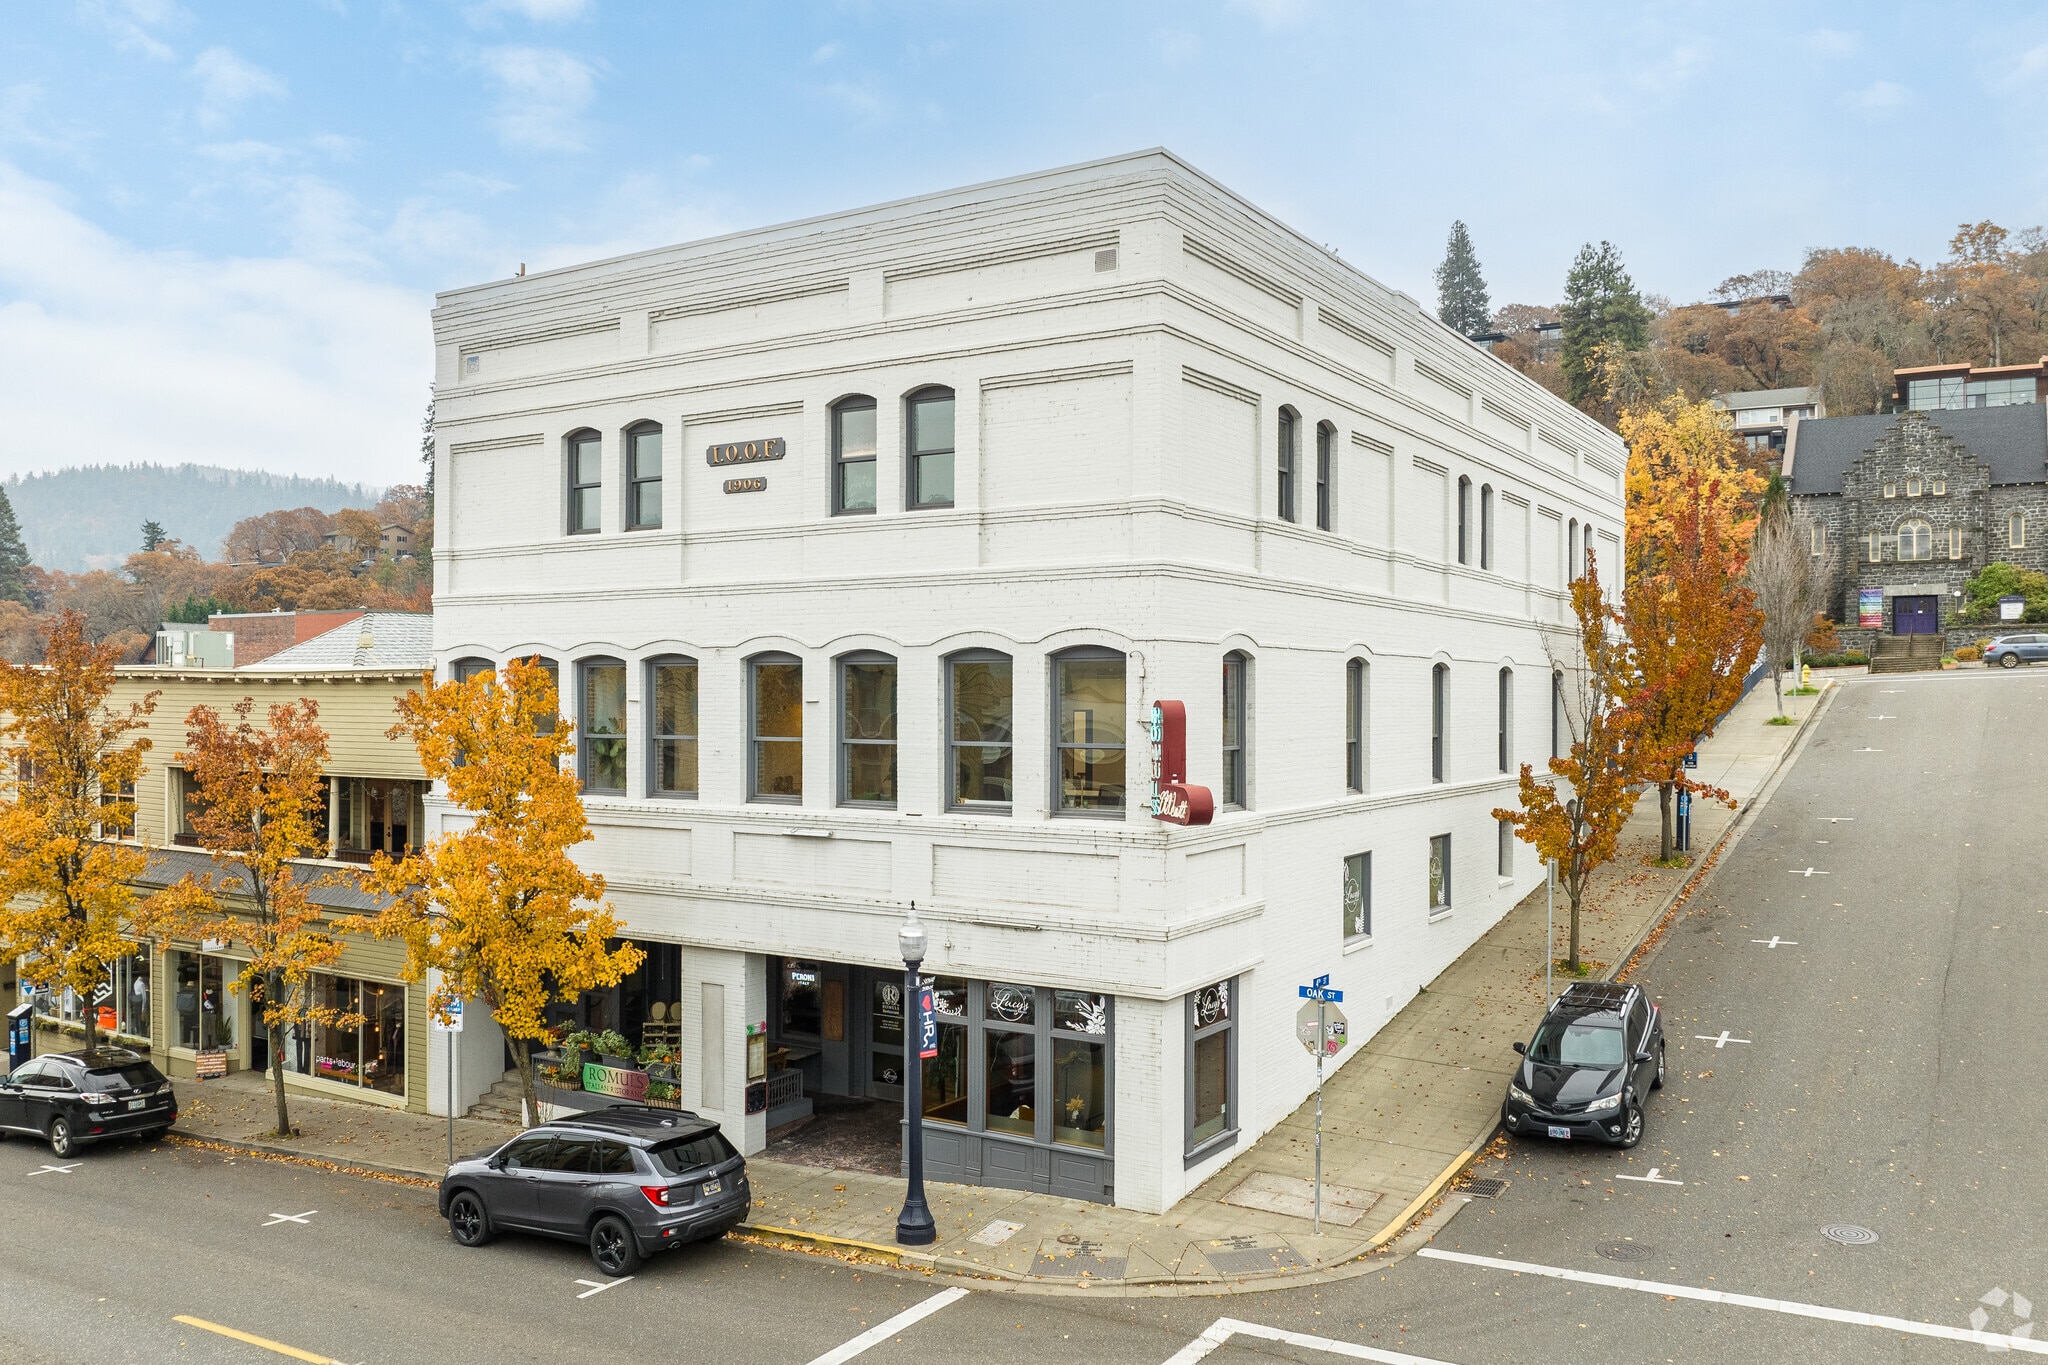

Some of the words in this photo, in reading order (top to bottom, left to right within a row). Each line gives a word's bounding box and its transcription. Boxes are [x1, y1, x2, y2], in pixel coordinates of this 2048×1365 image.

[728, 479, 761, 491] 1906
[1307, 989, 1323, 999] OAK
[1327, 991, 1335, 999] ST
[991, 991, 1029, 1015] Lucy's
